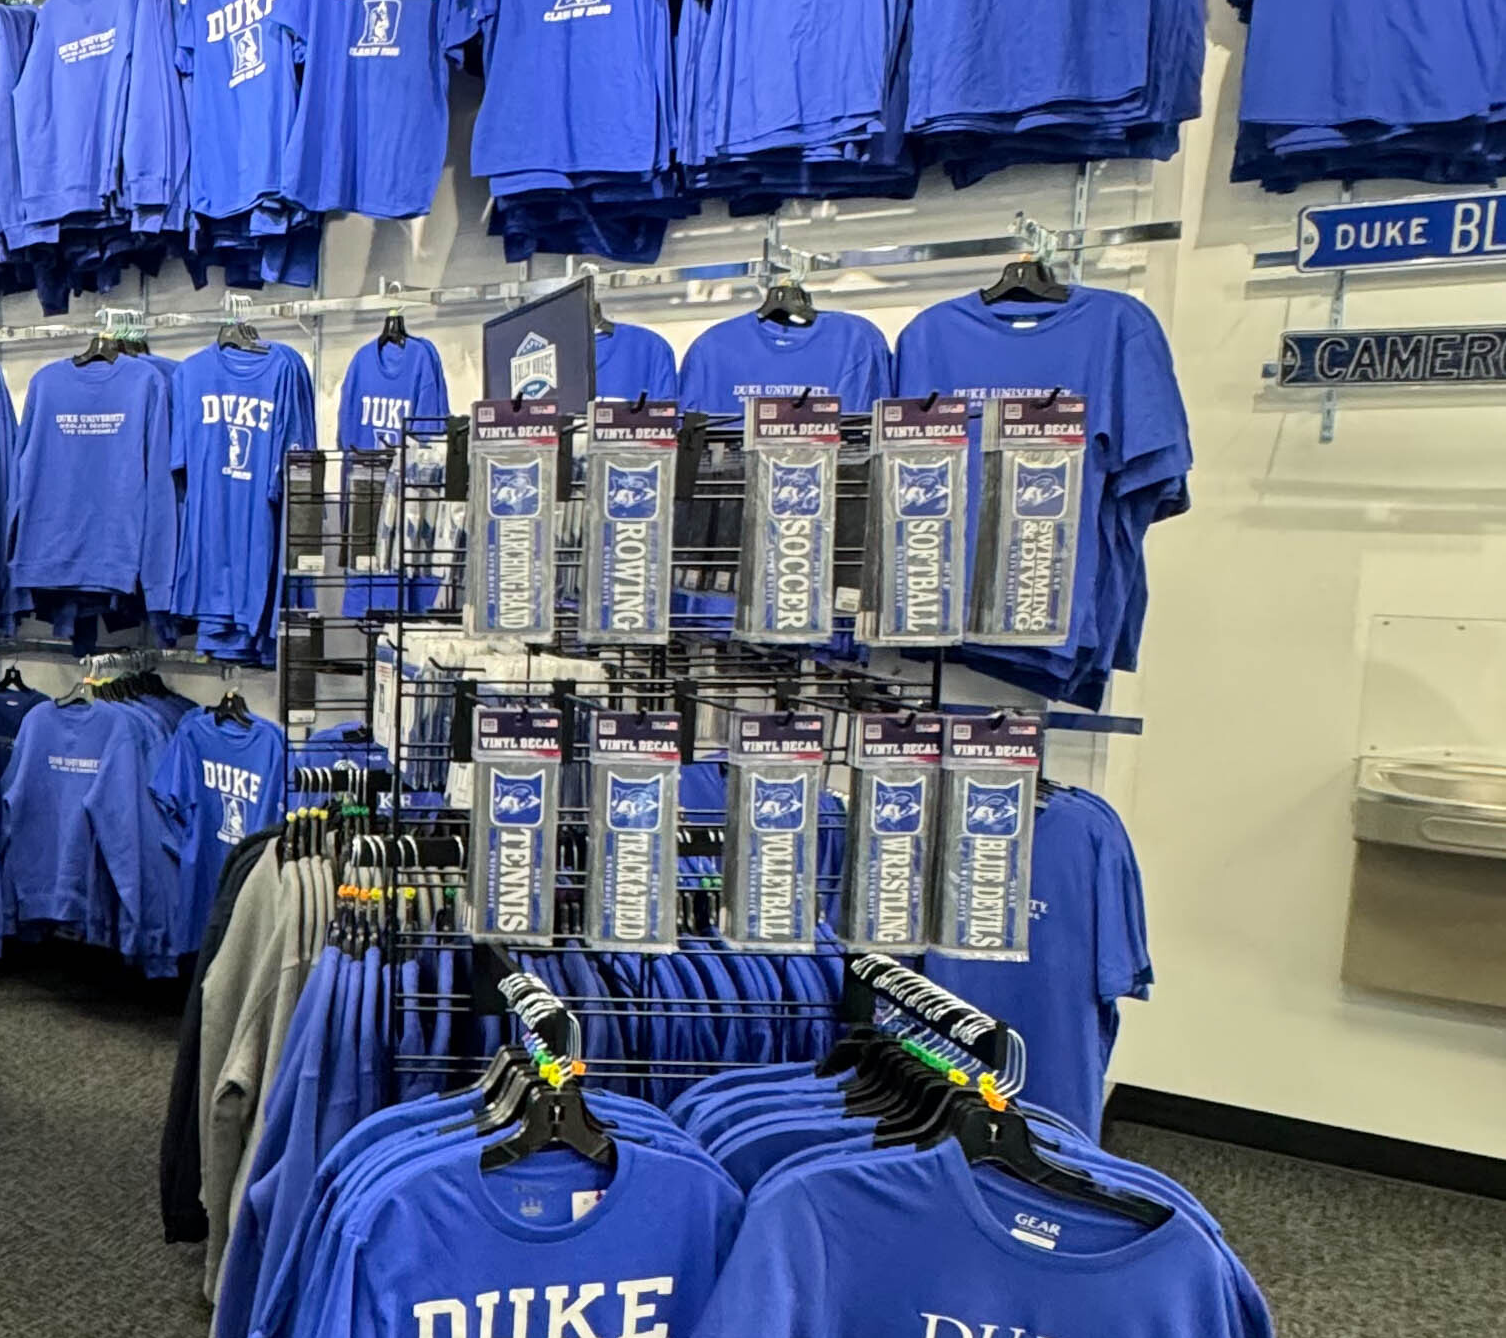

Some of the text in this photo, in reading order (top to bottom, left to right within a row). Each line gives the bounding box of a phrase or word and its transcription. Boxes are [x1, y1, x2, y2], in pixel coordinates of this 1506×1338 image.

[1335, 200, 1506, 254] DUKE BL
[1315, 333, 1506, 382] CAMER
[201, 394, 274, 432] DUKE
[733, 385, 762, 396] DUKE
[478, 424, 557, 439] VINYL DECAL
[595, 426, 676, 440] VINYL DECAL
[759, 423, 839, 436] VINYL DECAL
[884, 424, 966, 438] VINYL DECAL
[1004, 423, 1084, 436] VINYL DECAL
[499, 519, 531, 629] MARCHING BAND
[613, 521, 647, 631] ROWING
[776, 519, 811, 630] SOCCER
[906, 520, 940, 632] SOFTBALL
[1014, 520, 1039, 631] & DIVING
[1029, 520, 1054, 631] SWIMMING
[480, 737, 559, 750] VINYL DECAL
[599, 739, 678, 752] VINYL DECAL
[742, 740, 821, 753] VINYL DECAL
[865, 743, 940, 755] VINYL DECAL
[953, 745, 1036, 758] VINYL DECAL
[202, 759, 261, 804] DUKE
[497, 828, 531, 932] TENNIS
[614, 833, 649, 940] TRACK & FIELD
[759, 833, 793, 939] VOLLEYBALL
[877, 836, 911, 942] WRESTLING
[969, 838, 1007, 947] BLUE DEVILS
[1014, 1212, 1062, 1237] GEAR
